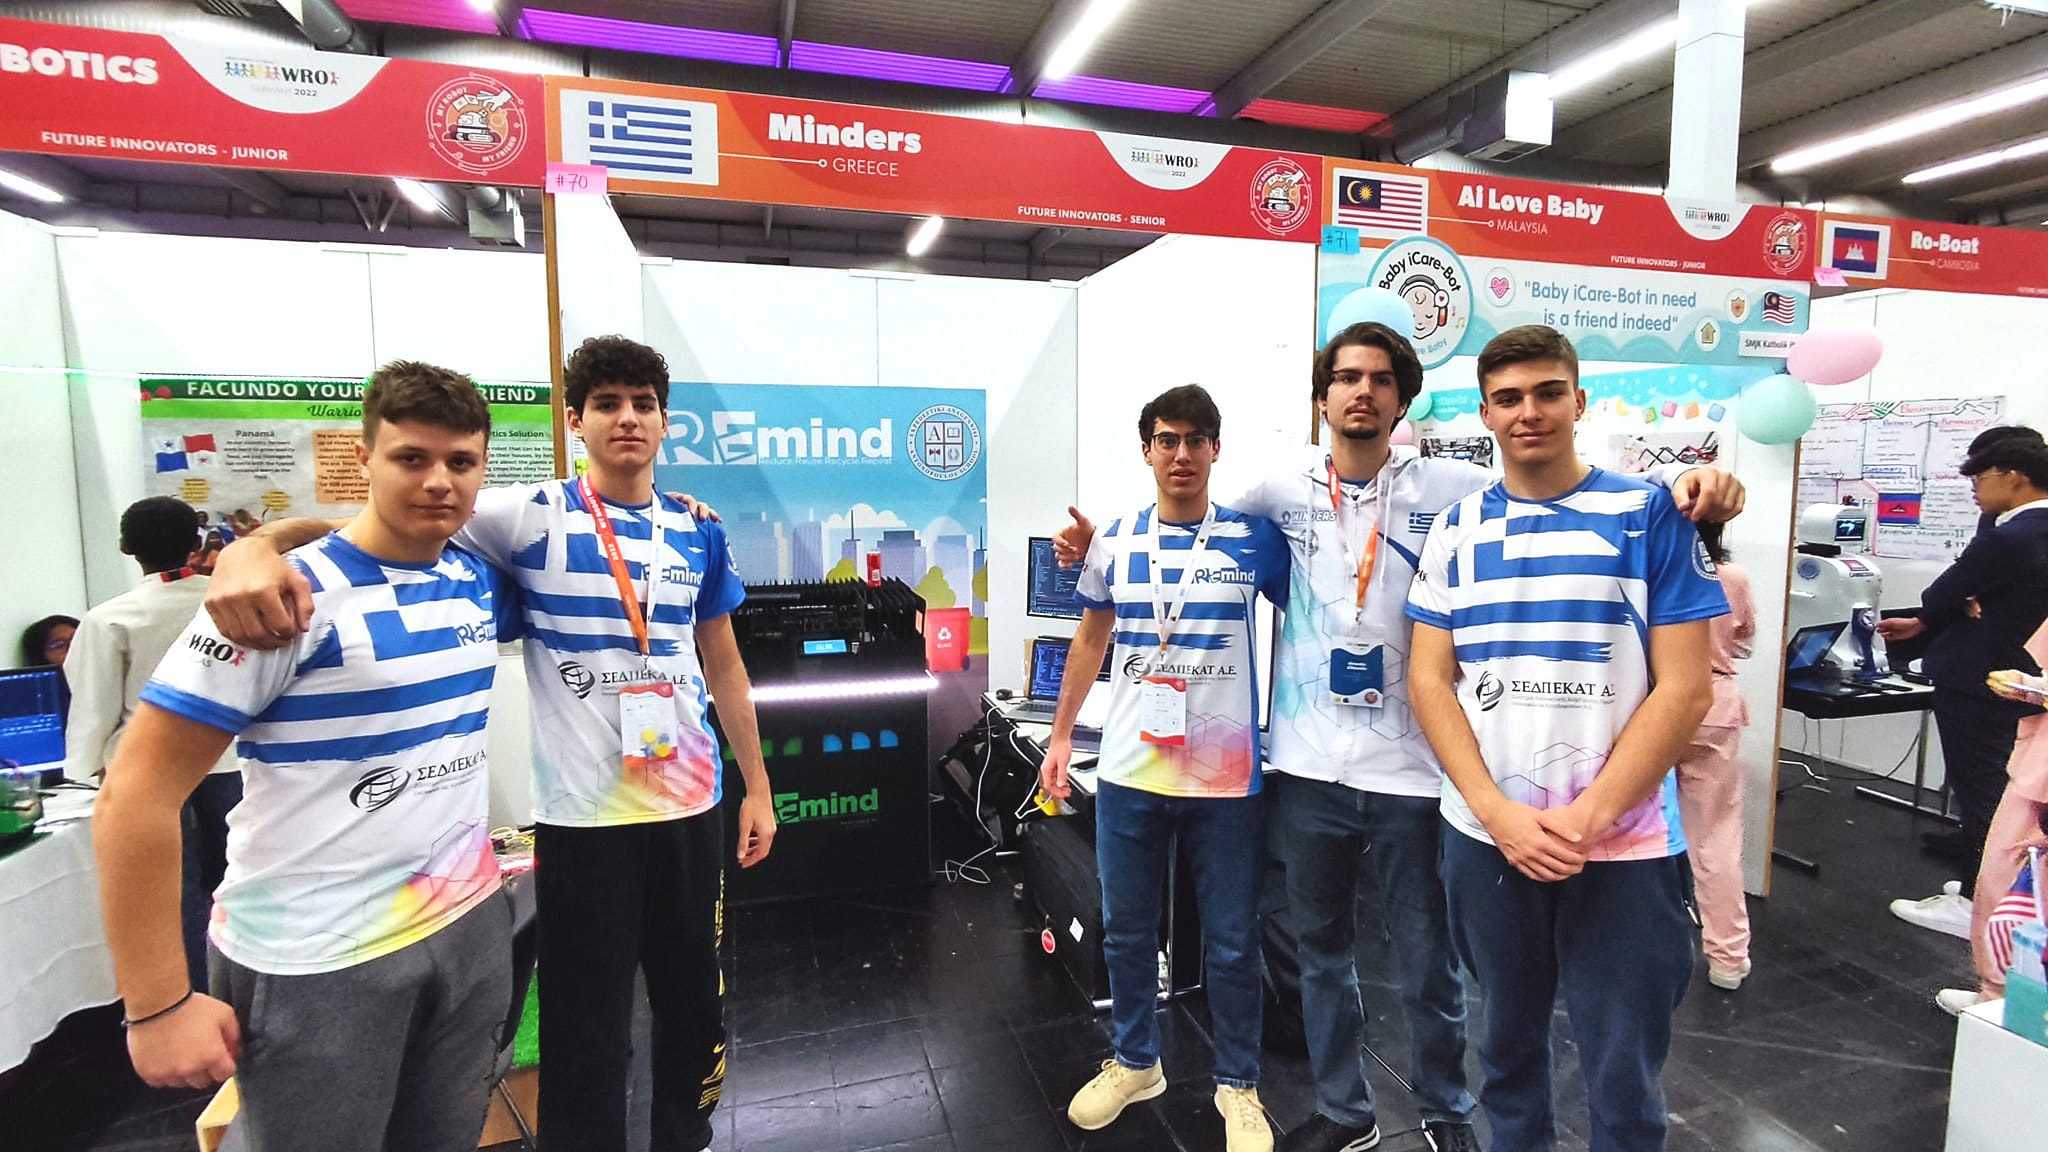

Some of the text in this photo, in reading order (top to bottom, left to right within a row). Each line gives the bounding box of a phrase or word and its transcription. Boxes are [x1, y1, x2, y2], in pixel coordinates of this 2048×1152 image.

[0, 43, 159, 85] BOTICS
[281, 67, 329, 85] WRO
[294, 88, 318, 97] 2022
[442, 87, 467, 105] ROBOT
[768, 112, 922, 154] Minders
[41, 131, 107, 147] FUTURE
[110, 136, 217, 156] INNOVATORS
[232, 146, 288, 161] JUNIOR
[495, 136, 517, 159] FRIEND
[832, 157, 899, 177] GREECE
[1165, 154, 1194, 168] WRO
[555, 174, 588, 189] #70
[1458, 184, 1605, 225] Ai Love Baby
[1018, 205, 1056, 218] FUTURE
[1058, 209, 1122, 223] INNOVATORS
[1130, 214, 1166, 226] SENIOR
[1707, 211, 1727, 222] WRO
[1496, 219, 1548, 235] MALAYSIA
[1325, 230, 1349, 251] #71
[1911, 230, 1979, 254] Ro-Boat
[1378, 251, 1462, 292] Baby iCare-Bot
[1611, 255, 1635, 264] FUTURE
[1636, 257, 1678, 267] INNOVATORS
[1682, 261, 1706, 270] JUNIOR
[1936, 258, 1980, 271] CAMBODIA
[1524, 280, 1697, 308] "Baby iCare-Bot in need
[1543, 308, 1678, 331] is a friend indeed"
[187, 381, 297, 397] FACUNDO
[306, 383, 366, 398] YOUR
[509, 430, 544, 438] Solution
[928, 425, 941, 441] A
[189, 633, 234, 661] WRO
[601, 669, 668, 684] ΣΕΔΠΕΚΑ
[774, 788, 878, 824] Emind
